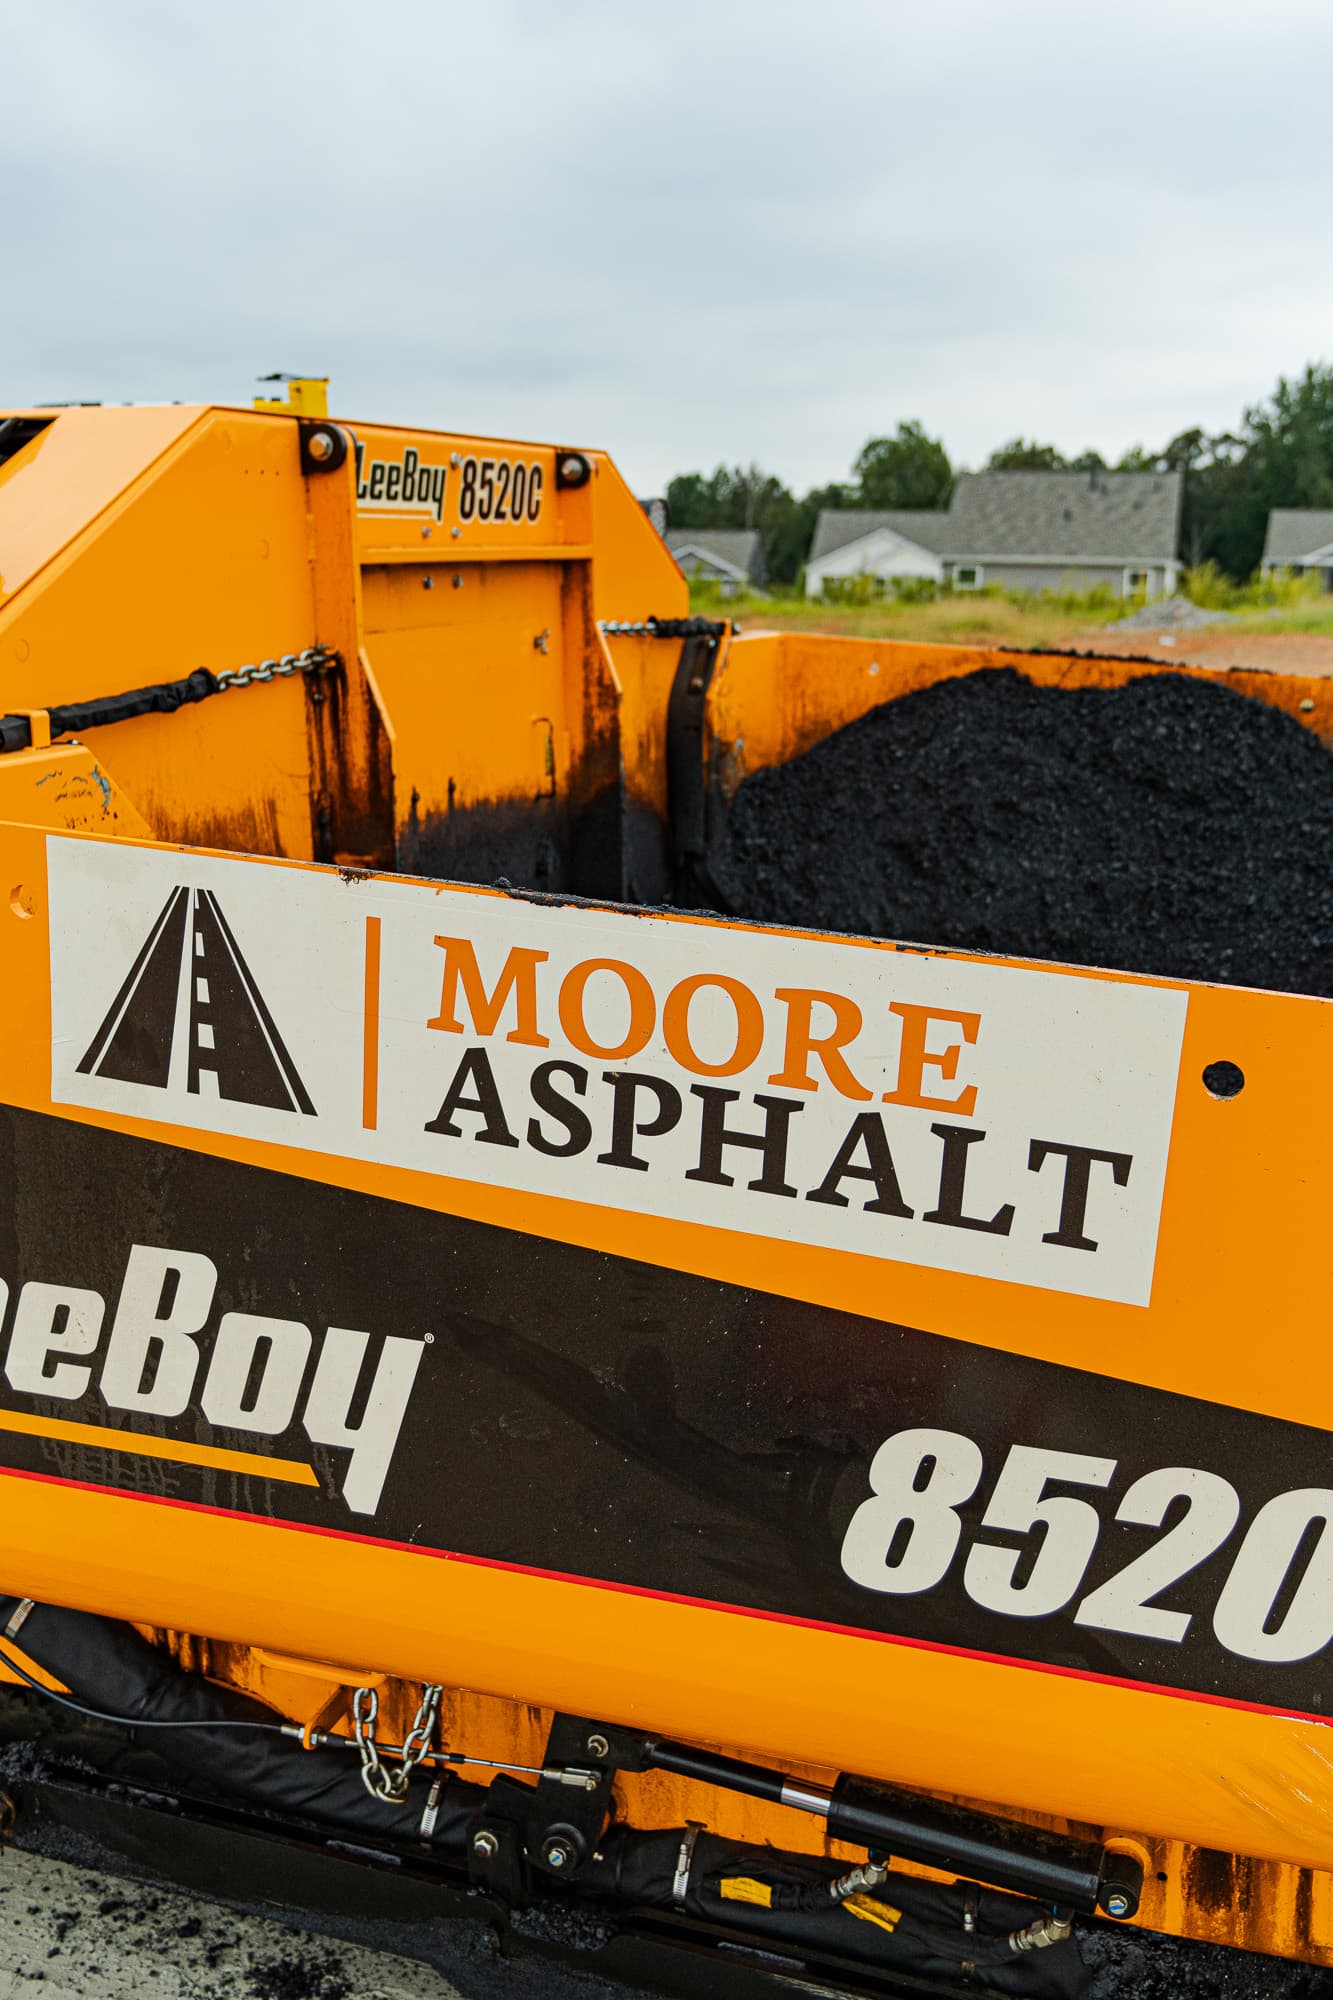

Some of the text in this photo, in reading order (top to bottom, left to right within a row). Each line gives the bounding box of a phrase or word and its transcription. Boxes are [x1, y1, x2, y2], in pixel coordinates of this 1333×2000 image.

[356, 443, 542, 521] LeeBoy 8520C
[427, 935, 982, 1116] MOORE
[424, 1048, 1133, 1252] ASPHALT
[0, 1244, 1333, 1664] eBoy 8520
